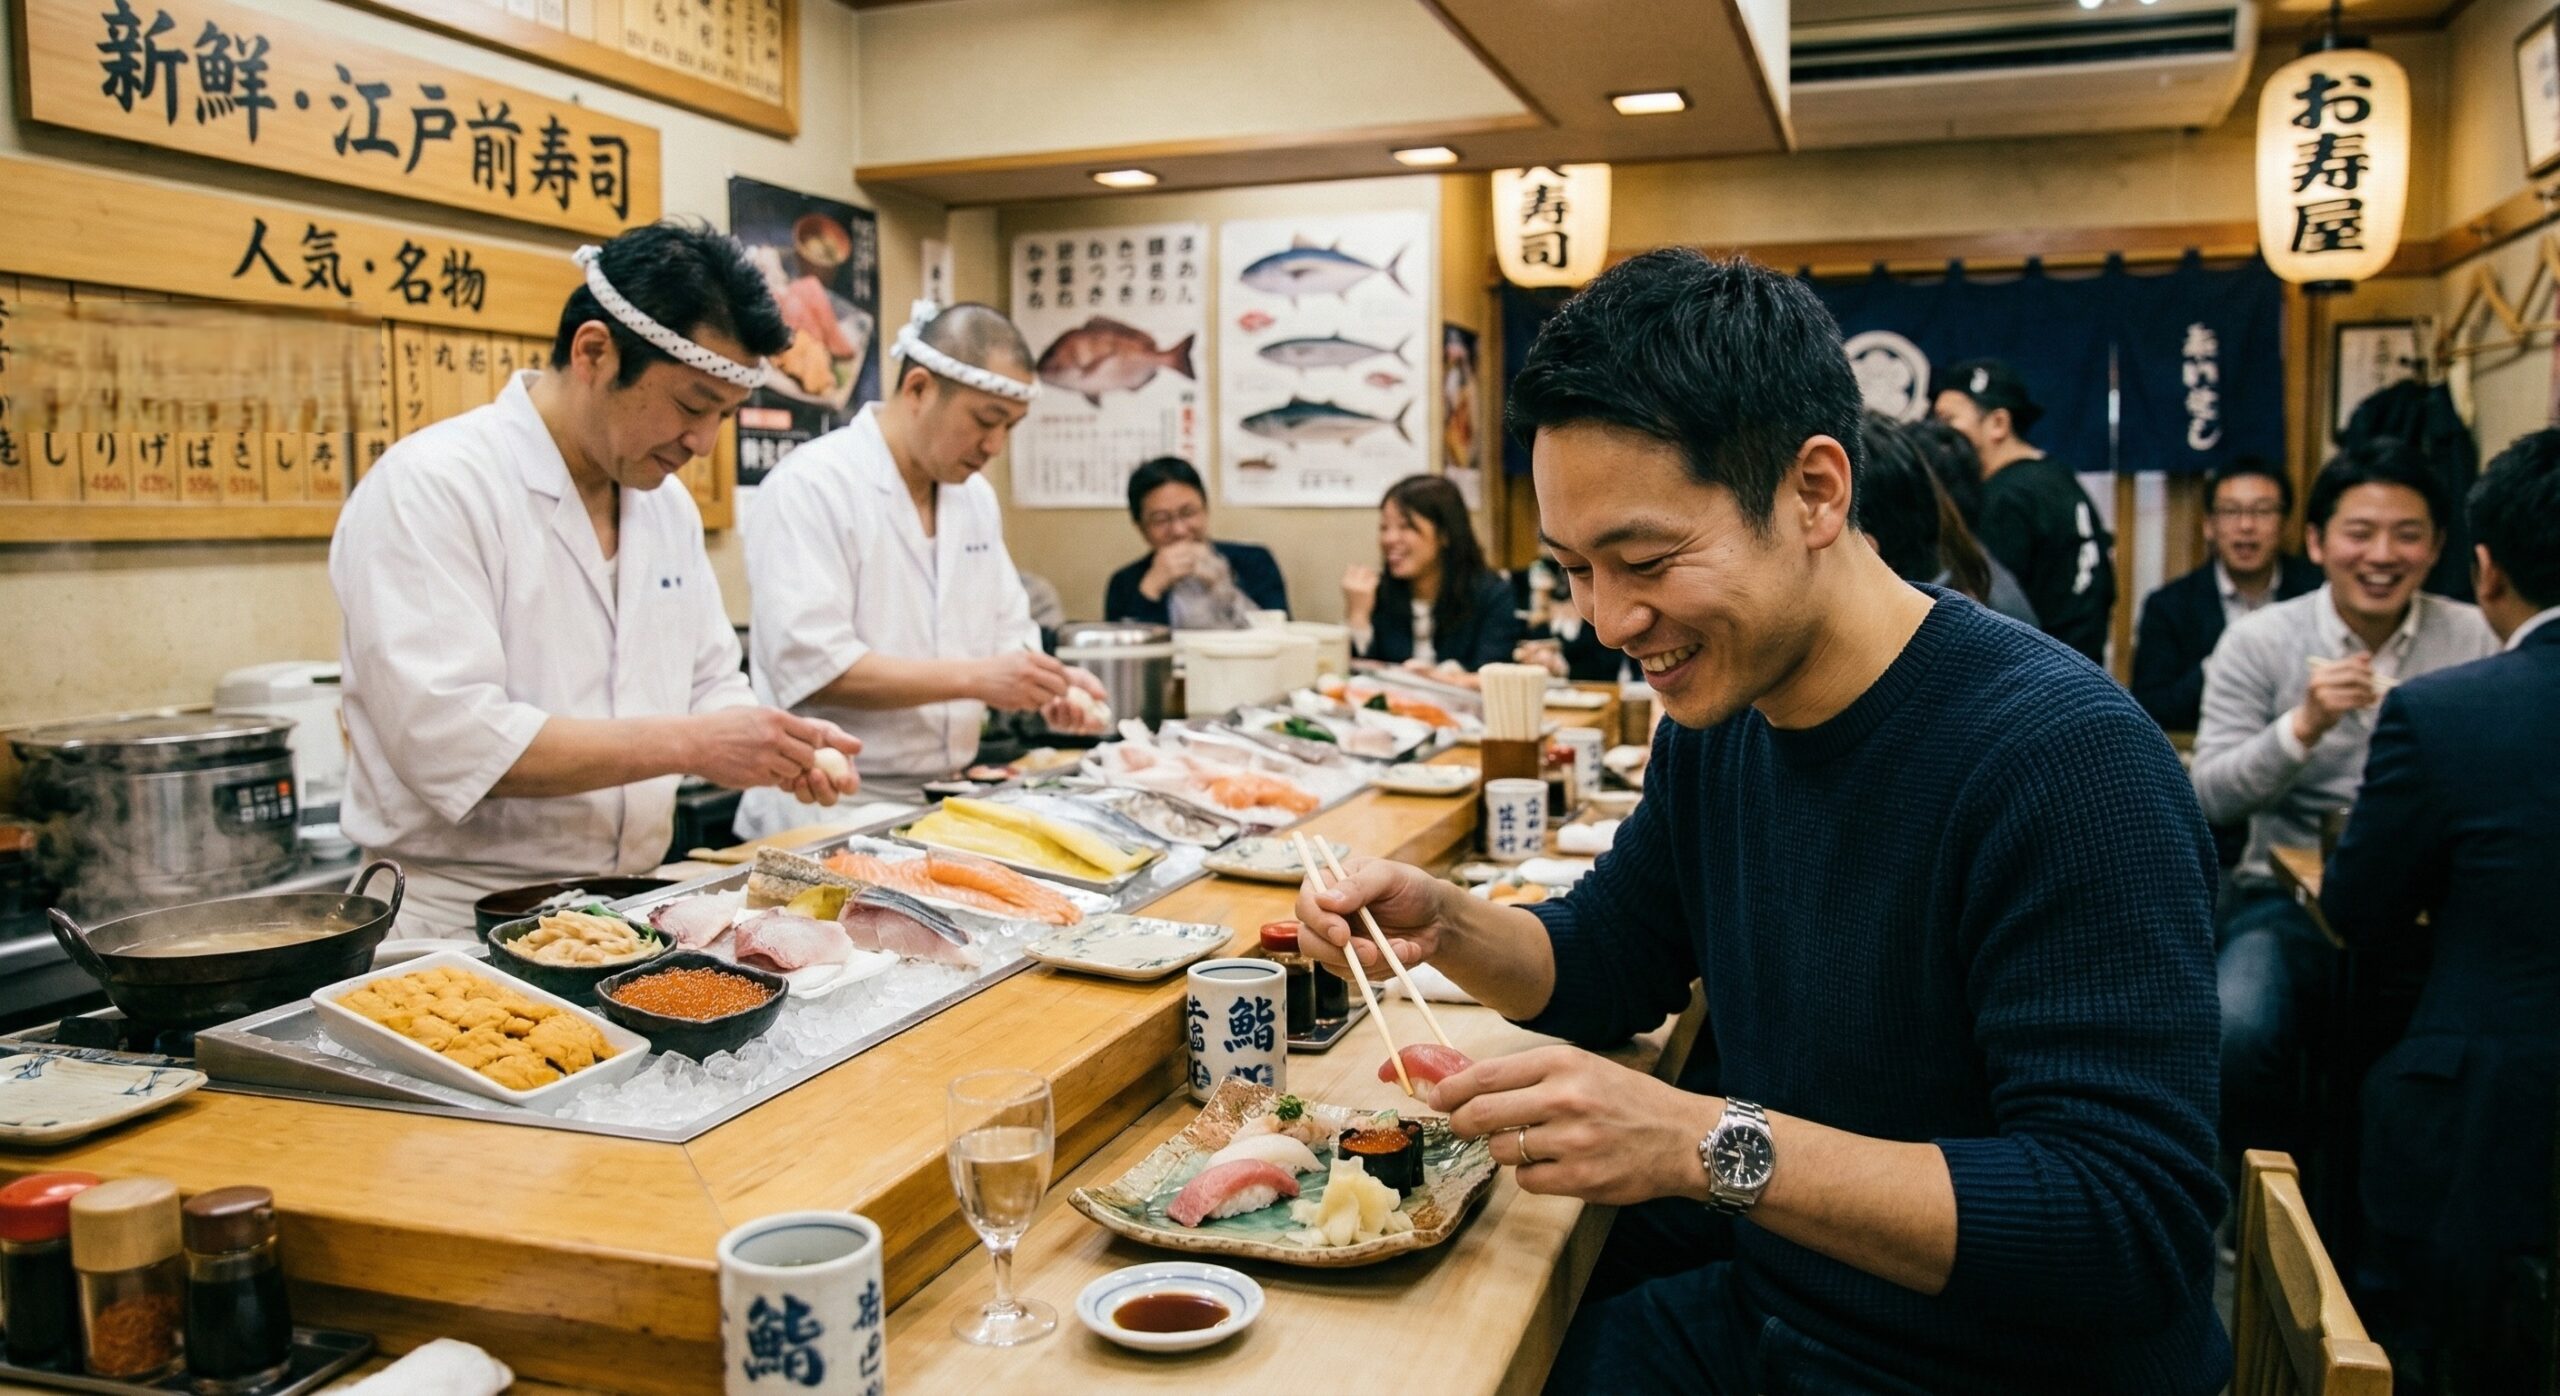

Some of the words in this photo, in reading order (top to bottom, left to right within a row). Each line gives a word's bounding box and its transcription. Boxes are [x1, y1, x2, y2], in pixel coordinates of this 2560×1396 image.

[97, 0, 631, 221] 新鮮・江戸前寿司
[2290, 72, 2372, 253] お寿屋
[232, 218, 486, 312] 人気・名物
[1519, 165, 1569, 269] 寿司
[1223, 995, 1277, 1053] 鮨
